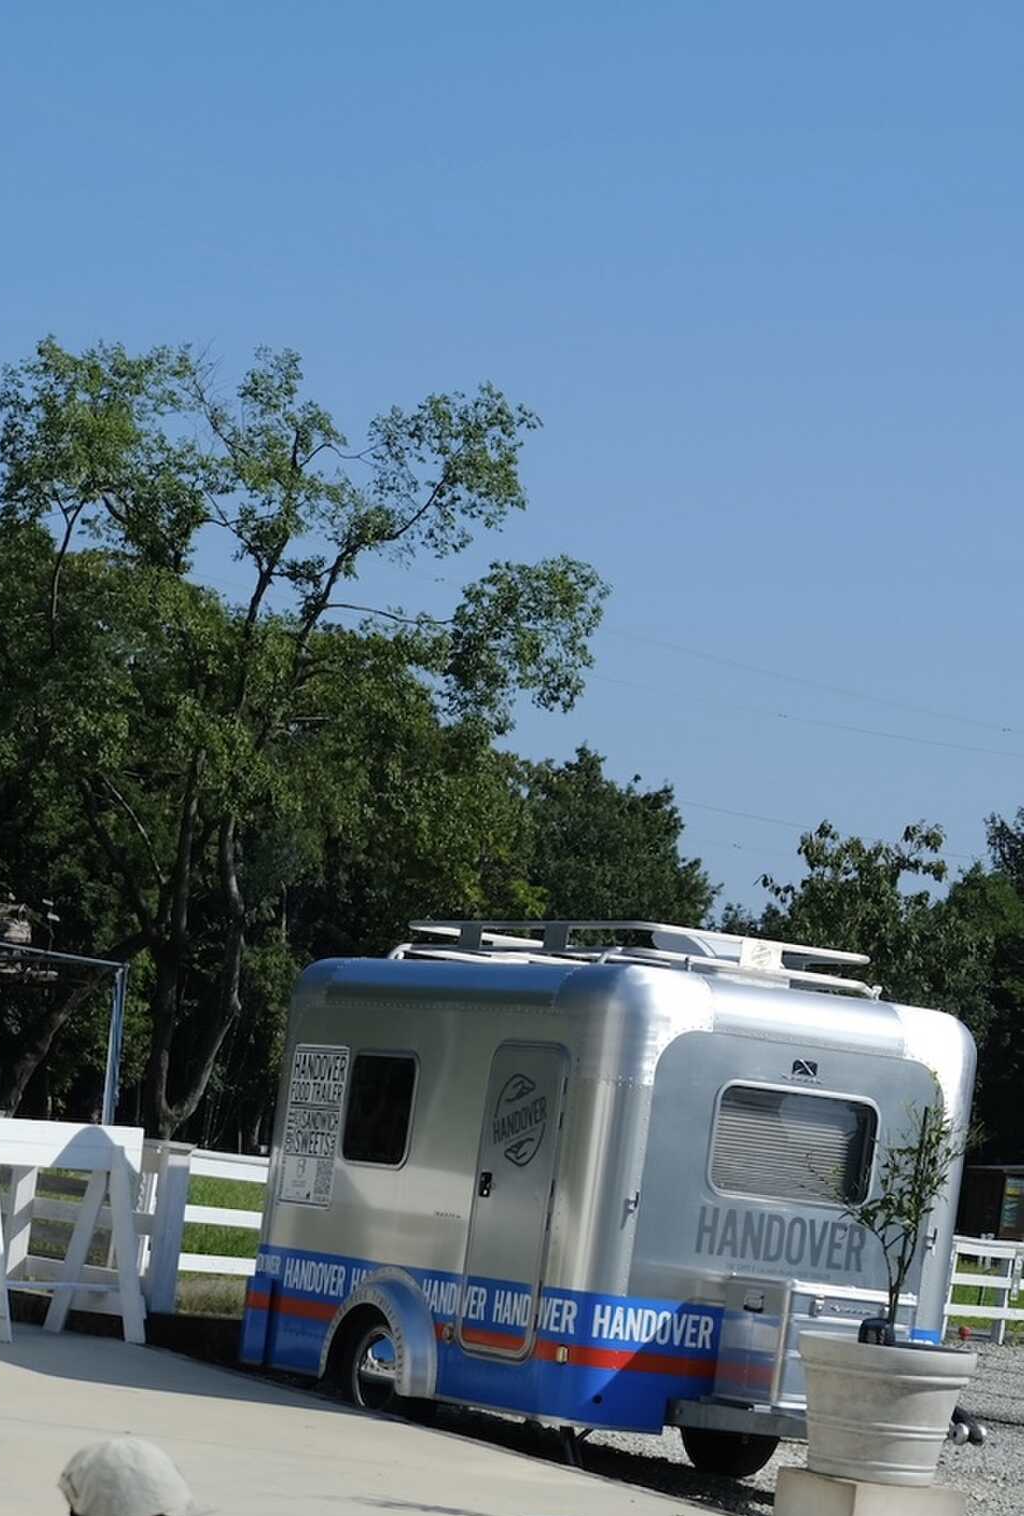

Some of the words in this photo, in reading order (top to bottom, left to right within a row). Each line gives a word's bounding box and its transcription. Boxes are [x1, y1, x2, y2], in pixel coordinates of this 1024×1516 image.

[294, 1054, 346, 1082] HANDOVER
[290, 1081, 311, 1101] FOOD
[312, 1082, 344, 1105] TRAILER
[493, 1096, 547, 1144] HANDOVER
[295, 1130, 331, 1156] SWEETS
[694, 1205, 868, 1273] HANDOVER
[282, 1257, 347, 1298] HANDOVER
[591, 1303, 715, 1350] HANDOVER
